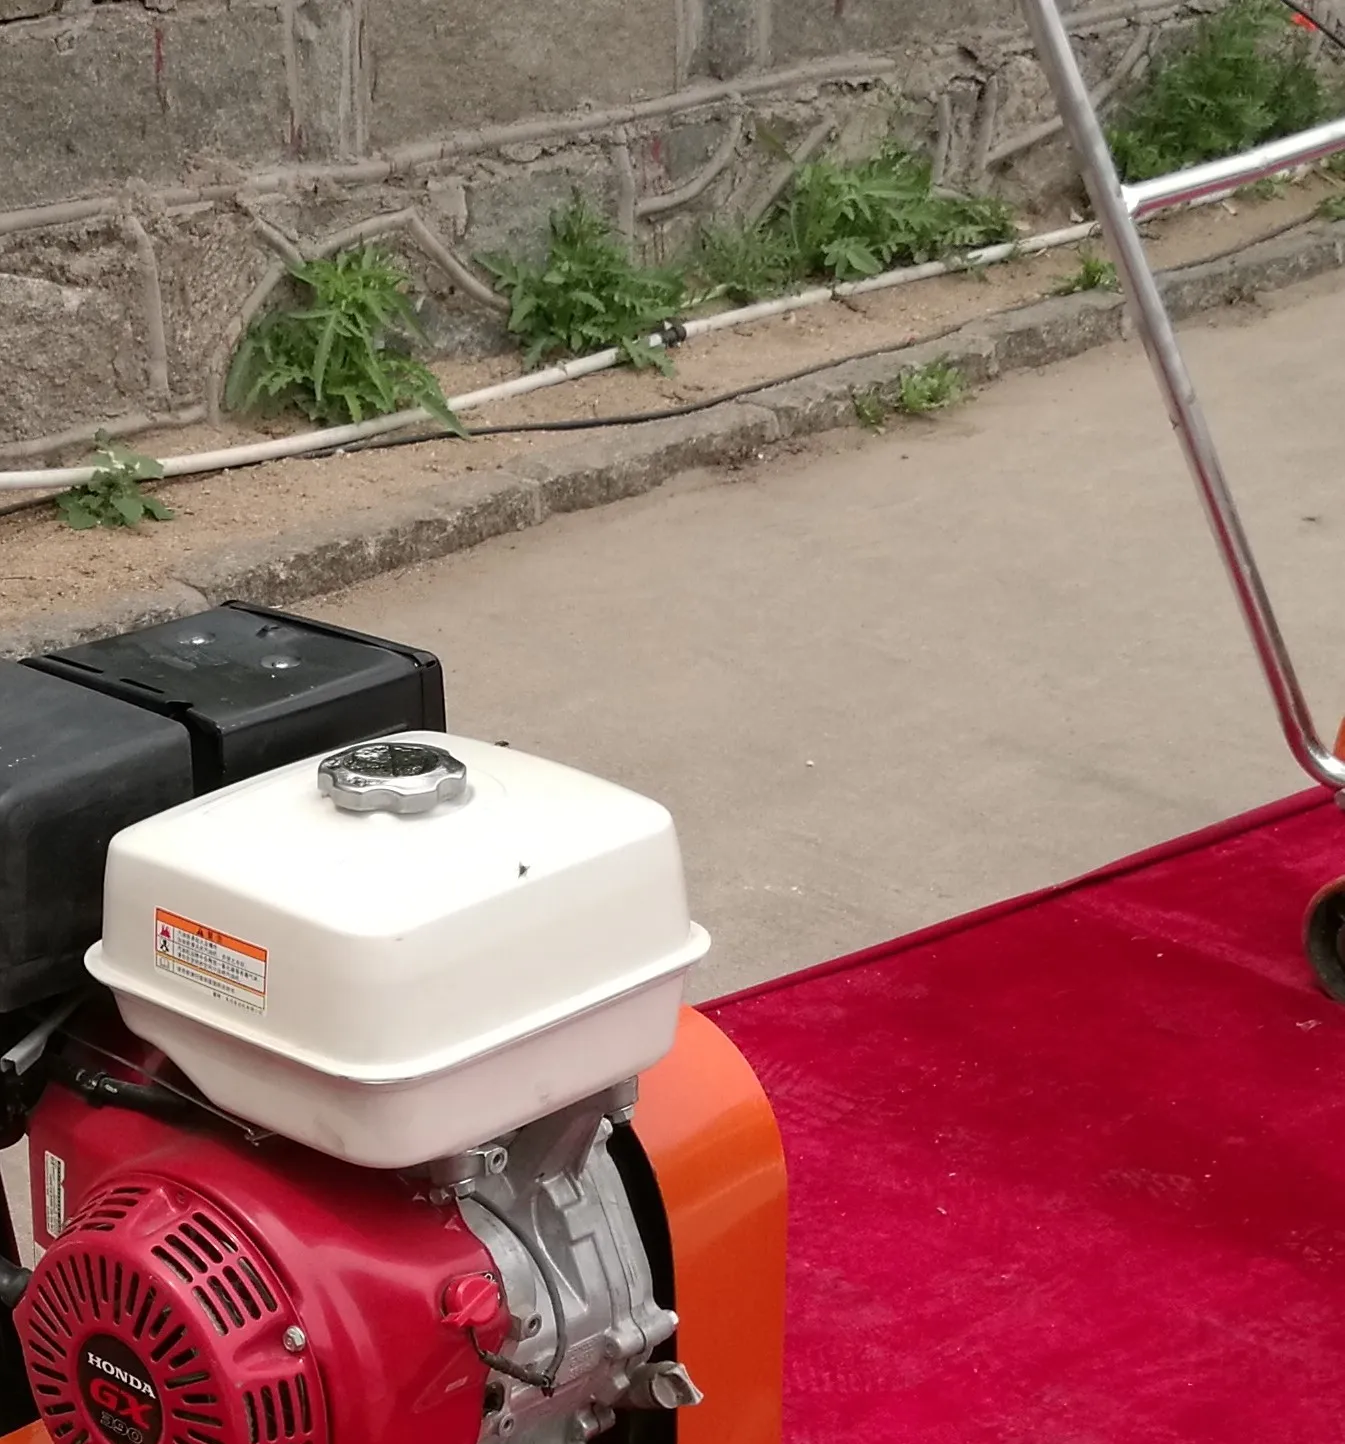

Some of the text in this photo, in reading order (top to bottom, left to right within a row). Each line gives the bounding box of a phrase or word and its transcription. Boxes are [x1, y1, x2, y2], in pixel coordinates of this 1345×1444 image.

[87, 1352, 156, 1399] HONDA
[89, 1378, 152, 1430] GX
[100, 1411, 143, 1444] 390
